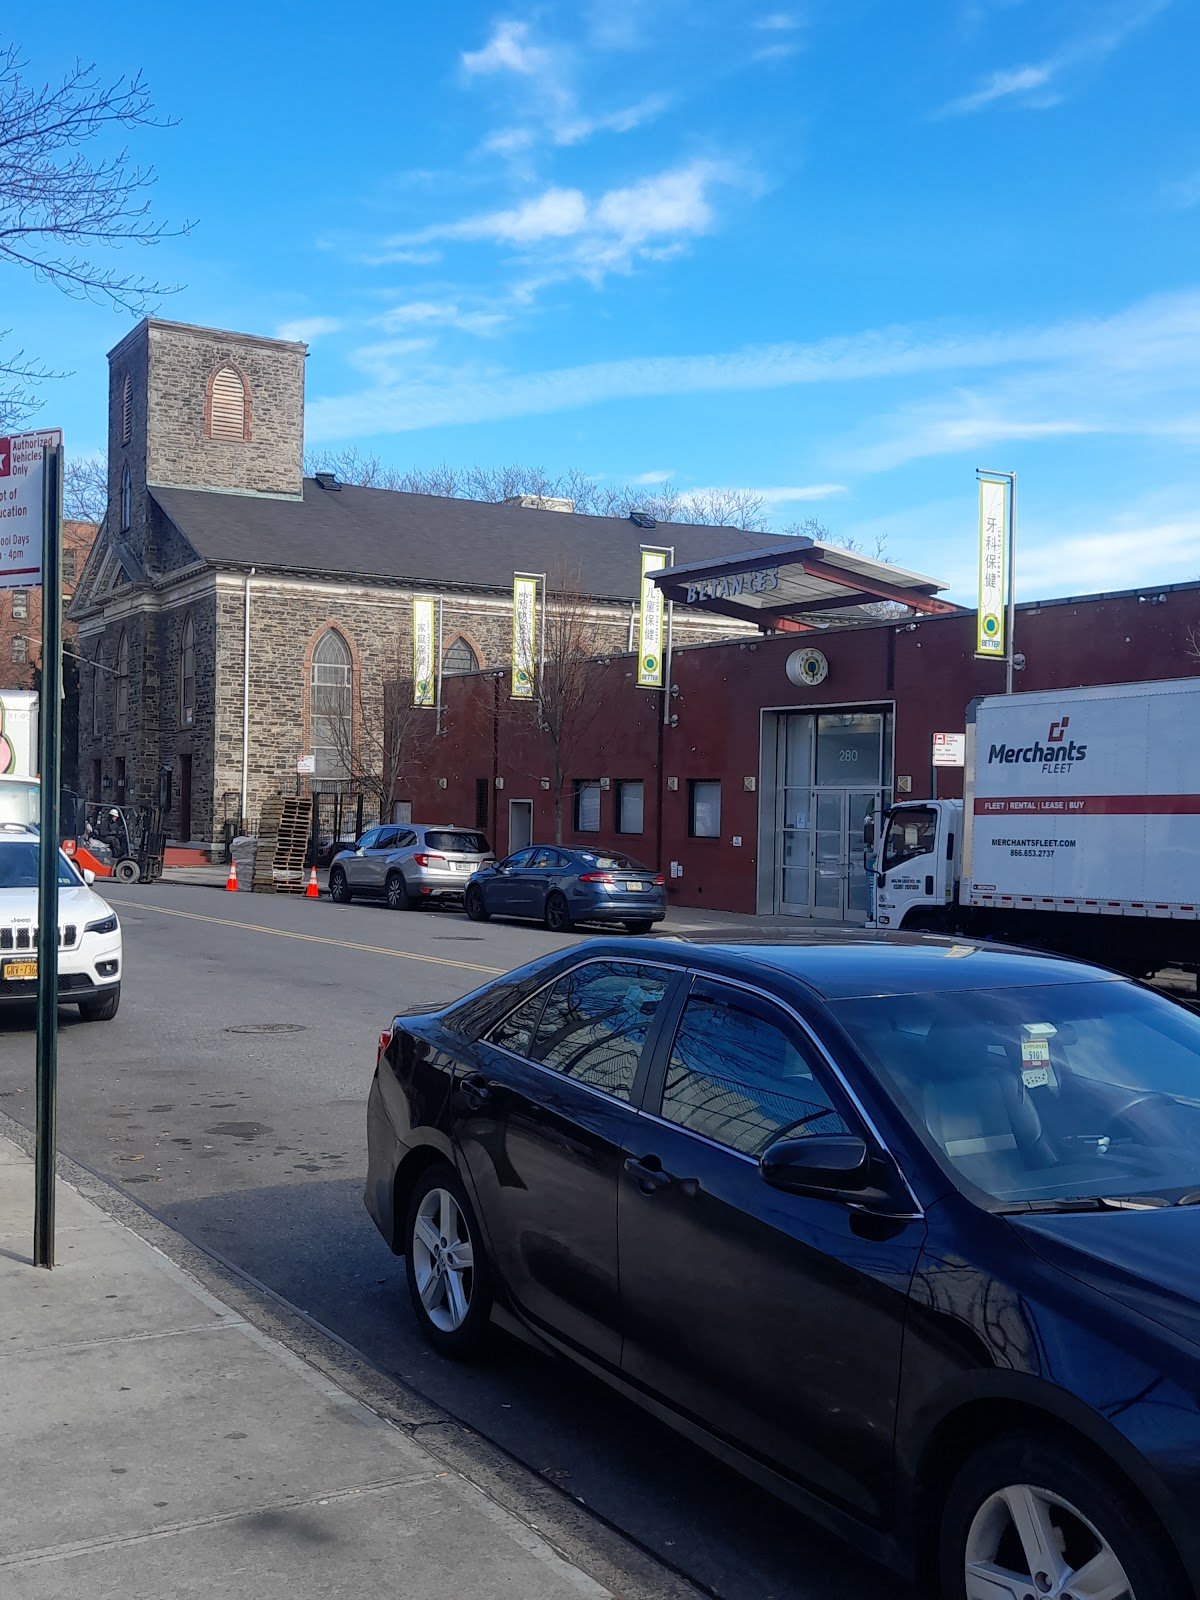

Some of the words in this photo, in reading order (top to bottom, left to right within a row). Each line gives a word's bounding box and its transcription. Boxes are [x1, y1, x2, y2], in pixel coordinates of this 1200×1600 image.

[12, 436, 53, 451] Authorized
[12, 450, 42, 463] Vehicles
[12, 464, 29, 478] Only
[9, 488, 18, 500] of
[13, 534, 30, 547] Days
[8, 548, 24, 561] 4pm
[985, 517, 997, 588] 牙科保健
[687, 569, 778, 603] BETANCES
[981, 639, 1000, 649] BETTER
[839, 750, 858, 761] 280
[988, 741, 1087, 764] Merchants
[1041, 763, 1073, 773] FLEET
[984, 802, 1005, 810] FLEET
[1009, 801, 1036, 809] RENTAL
[1041, 801, 1064, 809] LEASE
[1069, 801, 1085, 809] BUY
[991, 838, 1076, 847] MERCHANTSFLEET.COM
[1010, 849, 1055, 858] 866.653.2737
